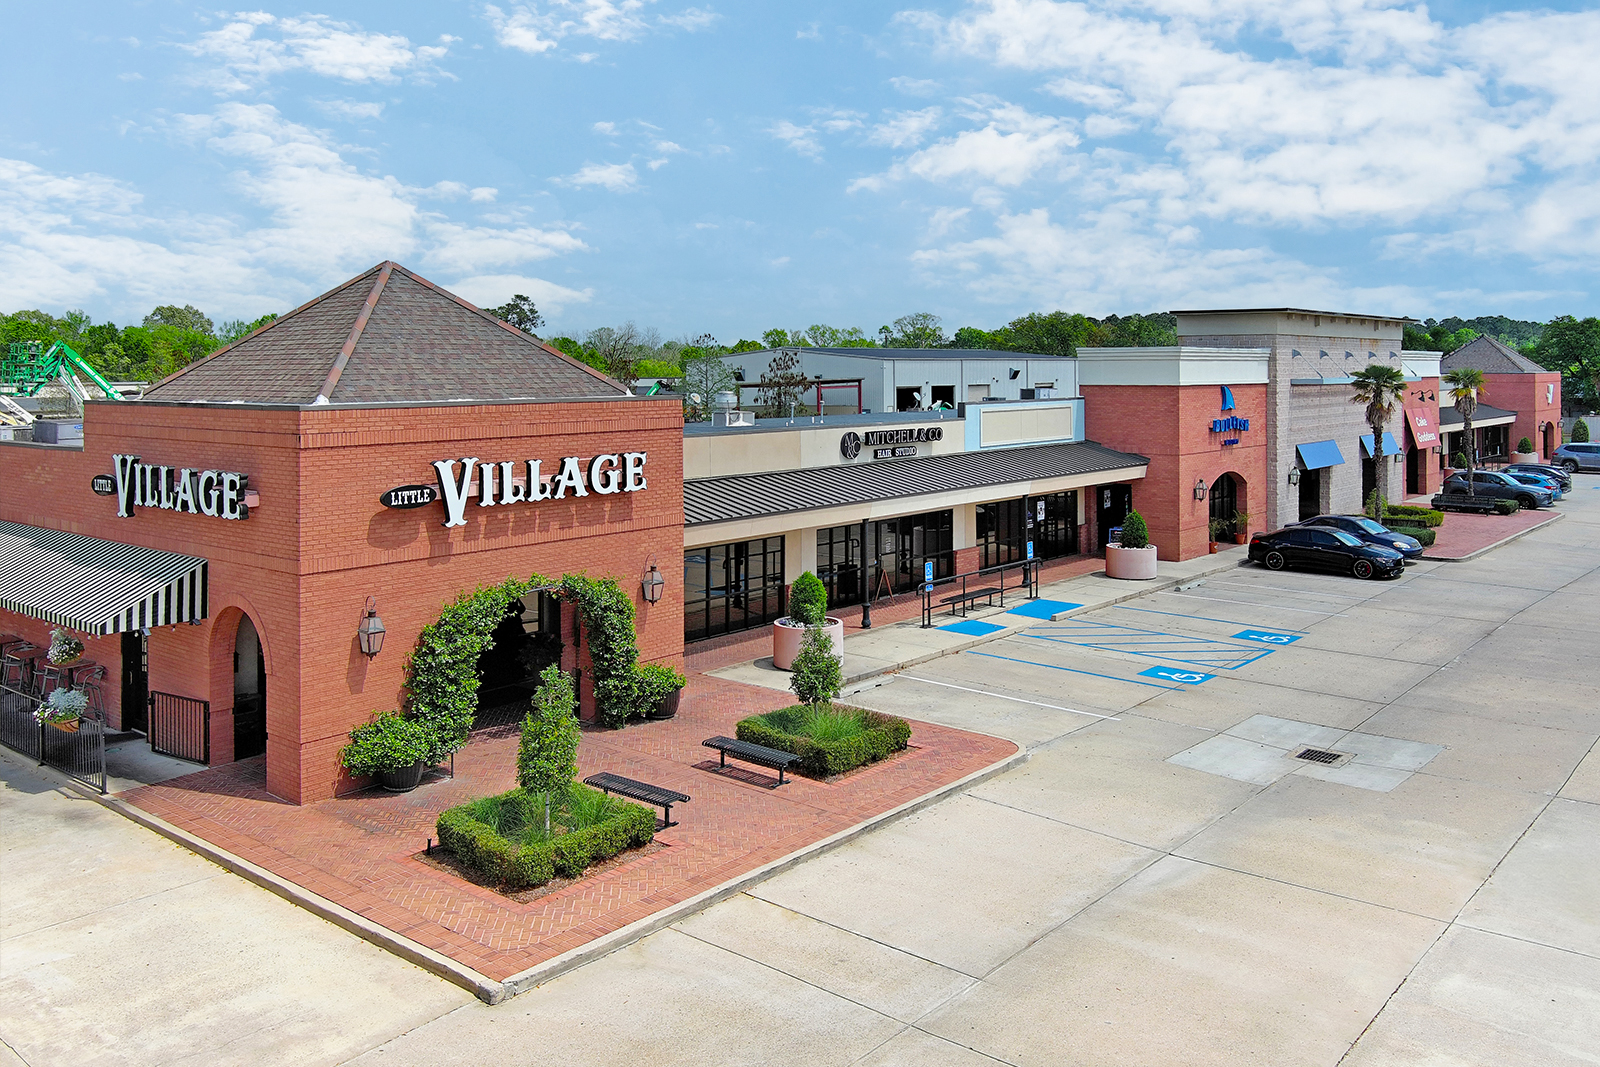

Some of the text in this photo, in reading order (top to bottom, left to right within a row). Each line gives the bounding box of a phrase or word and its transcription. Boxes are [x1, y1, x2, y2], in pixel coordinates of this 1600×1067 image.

[868, 427, 944, 446] MITCHELL & CO
[877, 447, 916, 458] HAIR STUDIO
[94, 453, 243, 521] LITTLE VILLAGE
[390, 451, 648, 528] LITTLE VILLAGE
